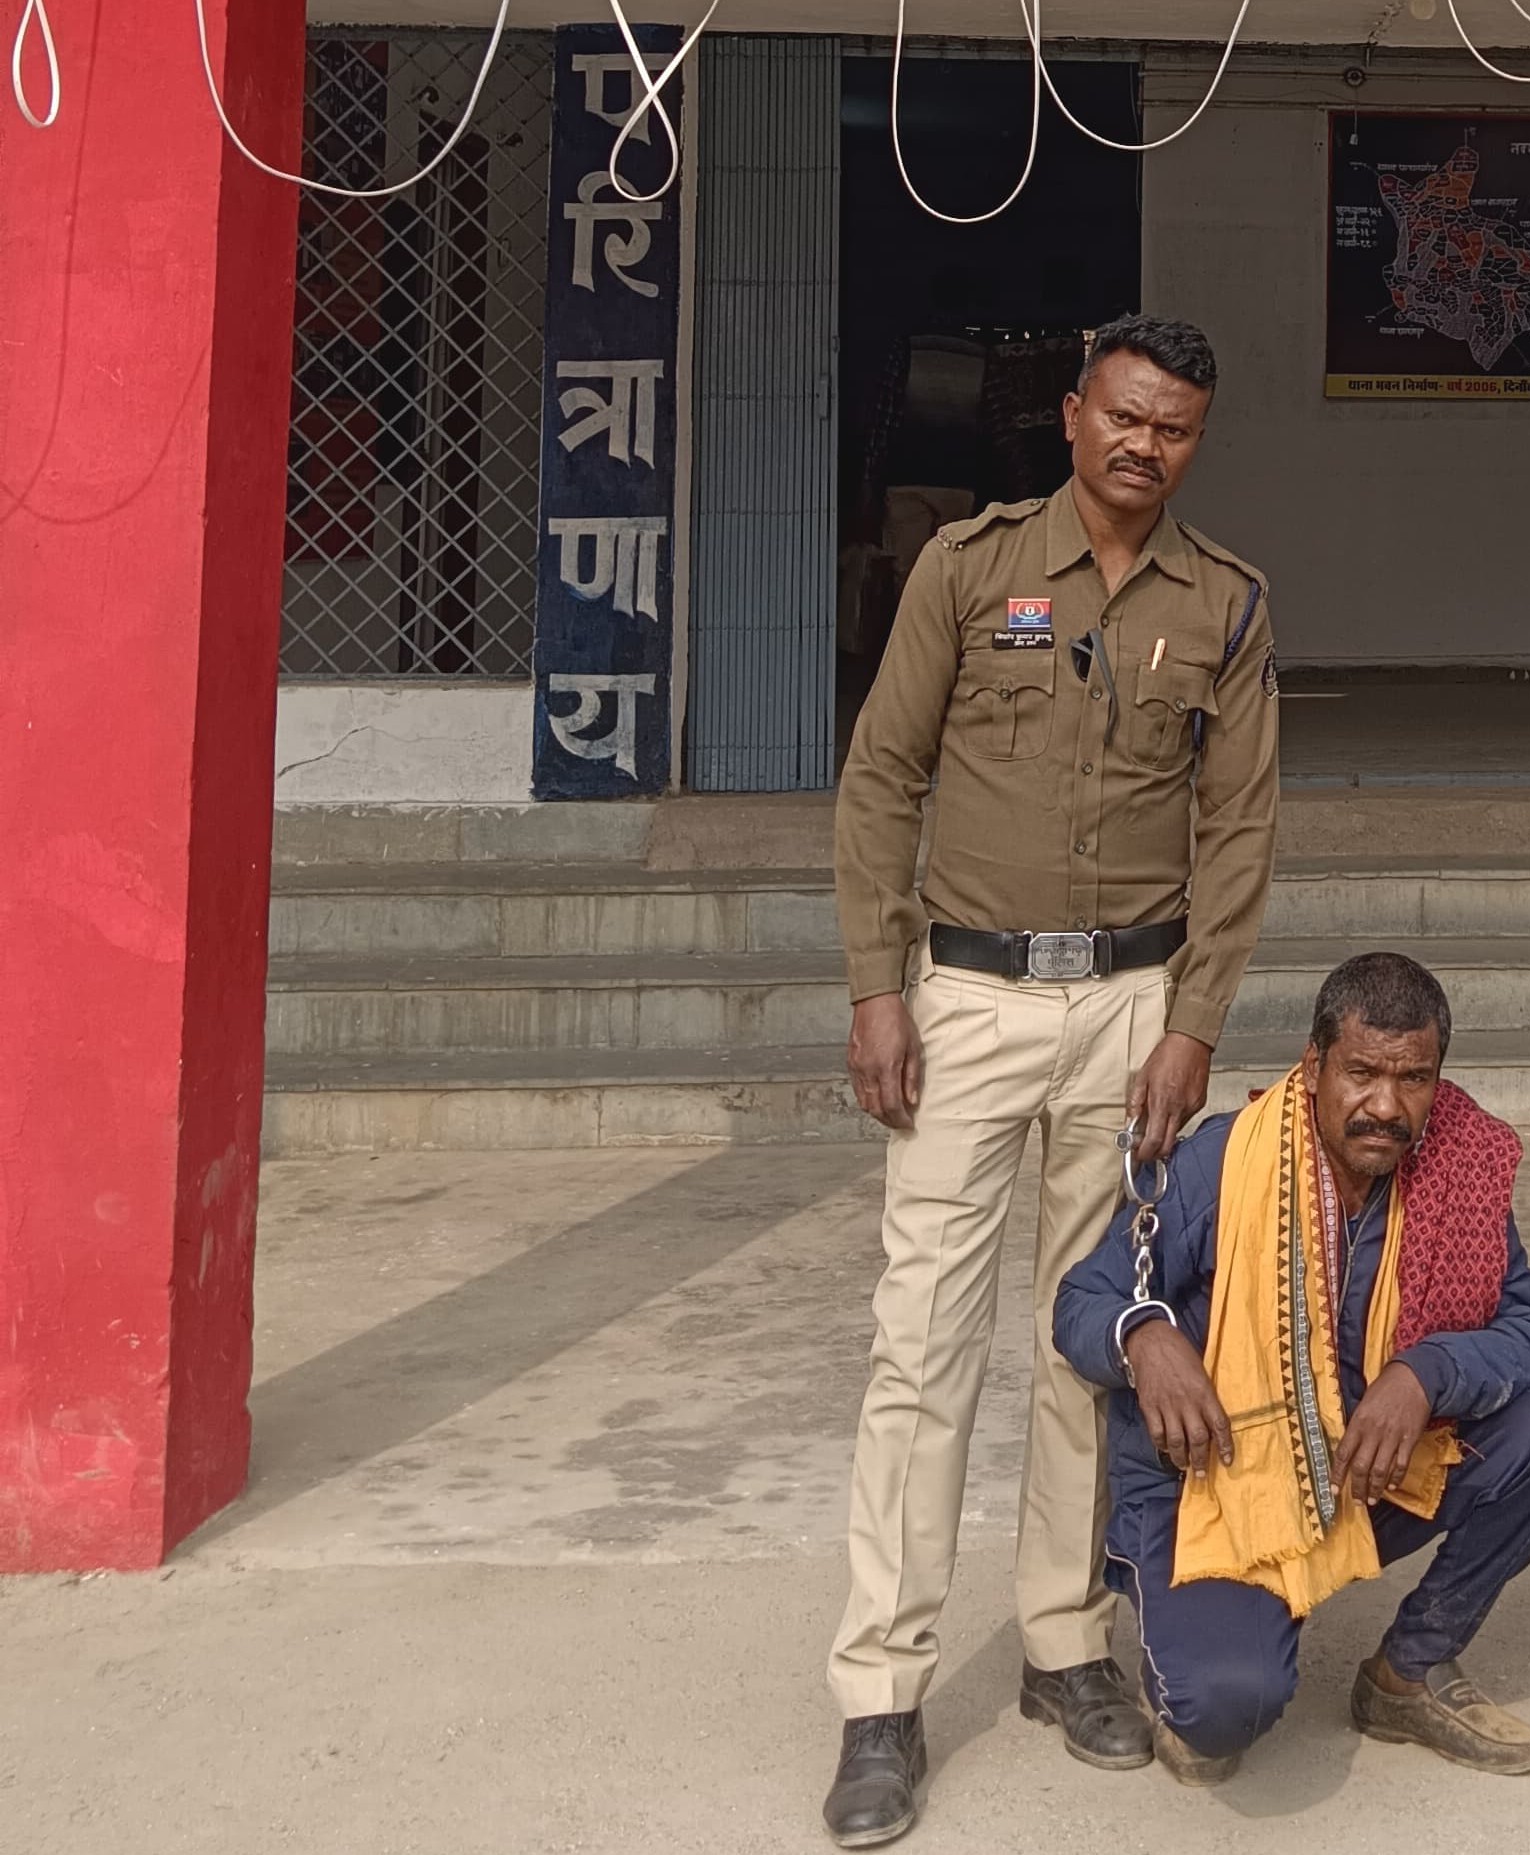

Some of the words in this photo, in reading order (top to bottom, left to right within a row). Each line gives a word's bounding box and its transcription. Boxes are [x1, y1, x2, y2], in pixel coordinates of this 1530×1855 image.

[1348, 380, 1373, 391] थाना
[1376, 380, 1400, 391] भवन
[1447, 378, 1463, 391] वर्ष
